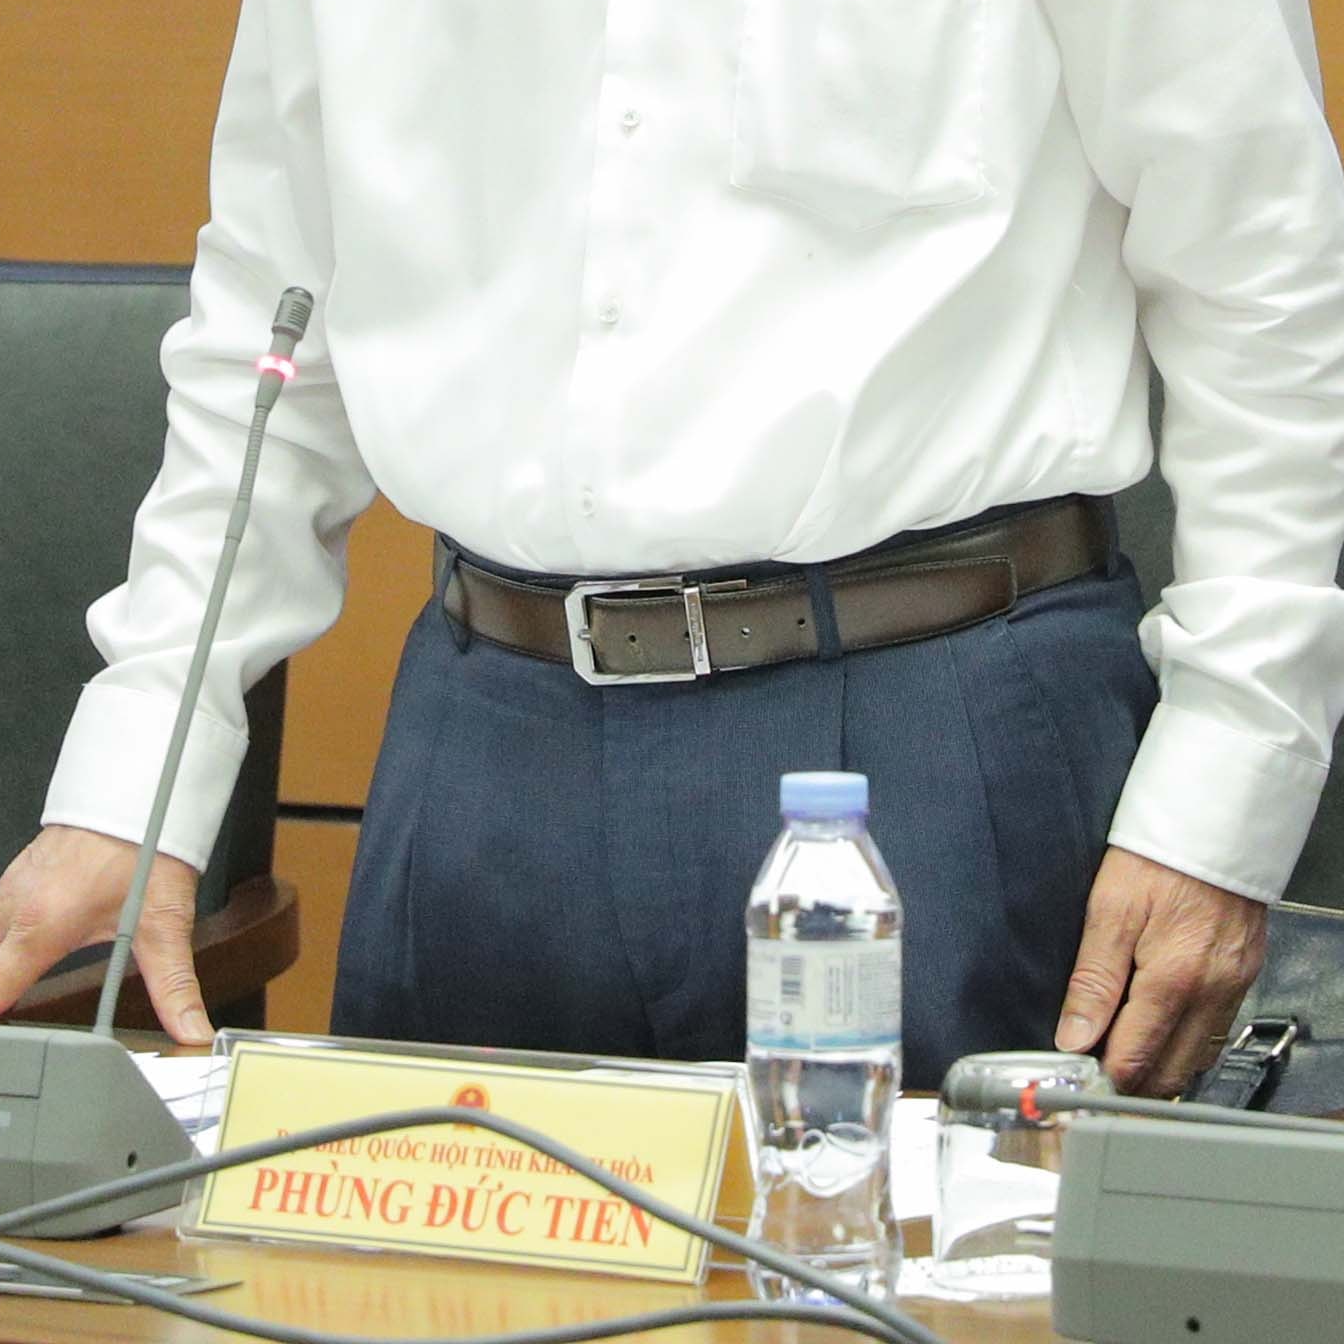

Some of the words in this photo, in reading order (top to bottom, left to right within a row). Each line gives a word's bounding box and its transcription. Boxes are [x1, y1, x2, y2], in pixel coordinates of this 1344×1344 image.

[428, 1141, 469, 1169] HỘI
[249, 1160, 415, 1225] PHÙNG
[423, 1172, 532, 1237] ĐỨC
